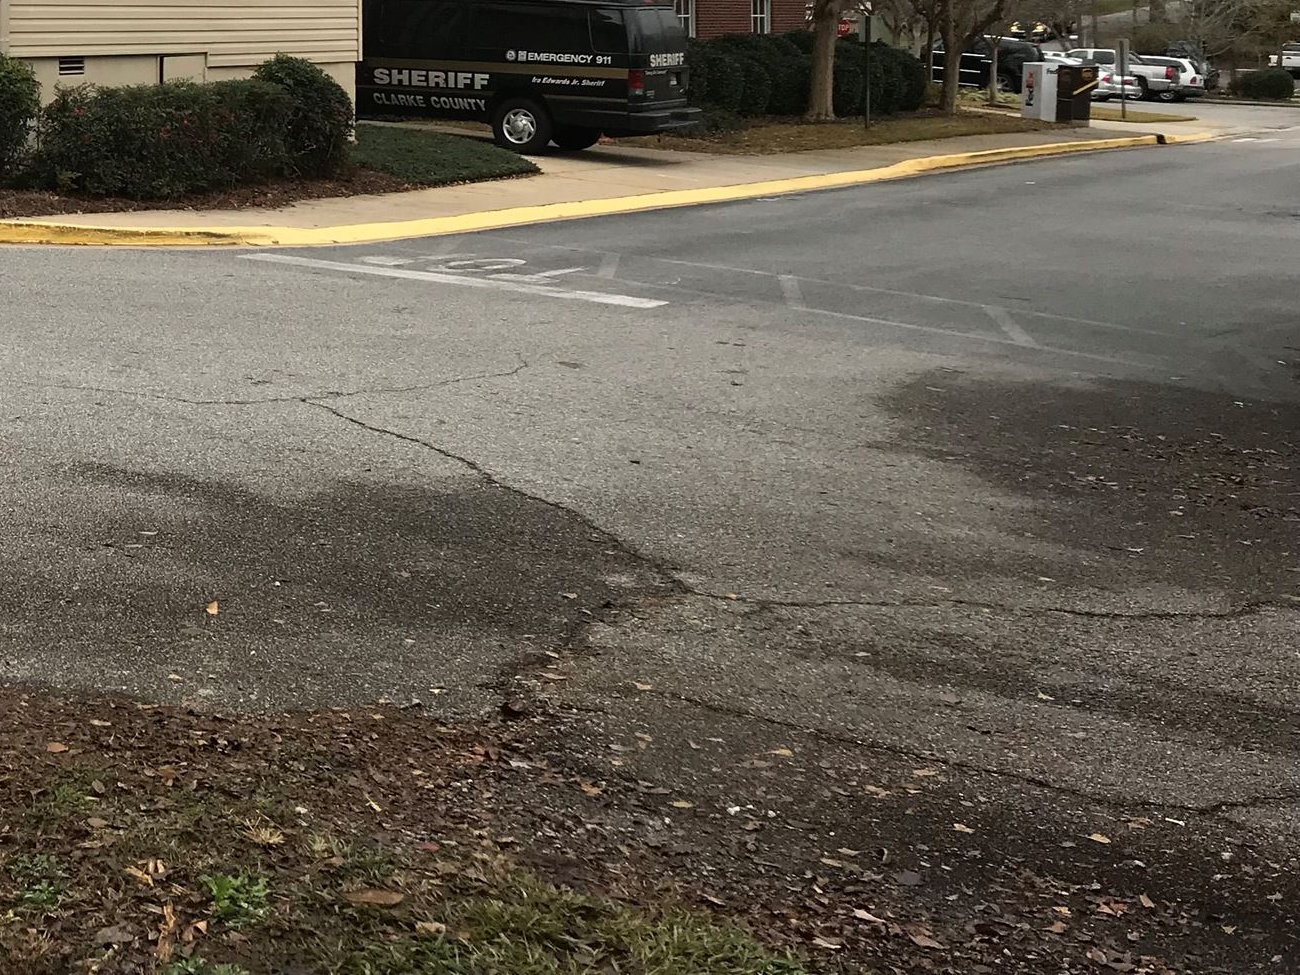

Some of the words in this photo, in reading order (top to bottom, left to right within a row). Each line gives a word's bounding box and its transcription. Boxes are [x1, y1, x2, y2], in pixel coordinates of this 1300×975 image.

[838, 23, 850, 31] TOP
[527, 52, 594, 64] EMERGENCY
[596, 55, 612, 65] 911
[650, 52, 685, 68] SHERIFF
[373, 68, 490, 90] SHERIFF
[373, 92, 427, 107] CLARKE
[430, 96, 486, 111] COUNTY
